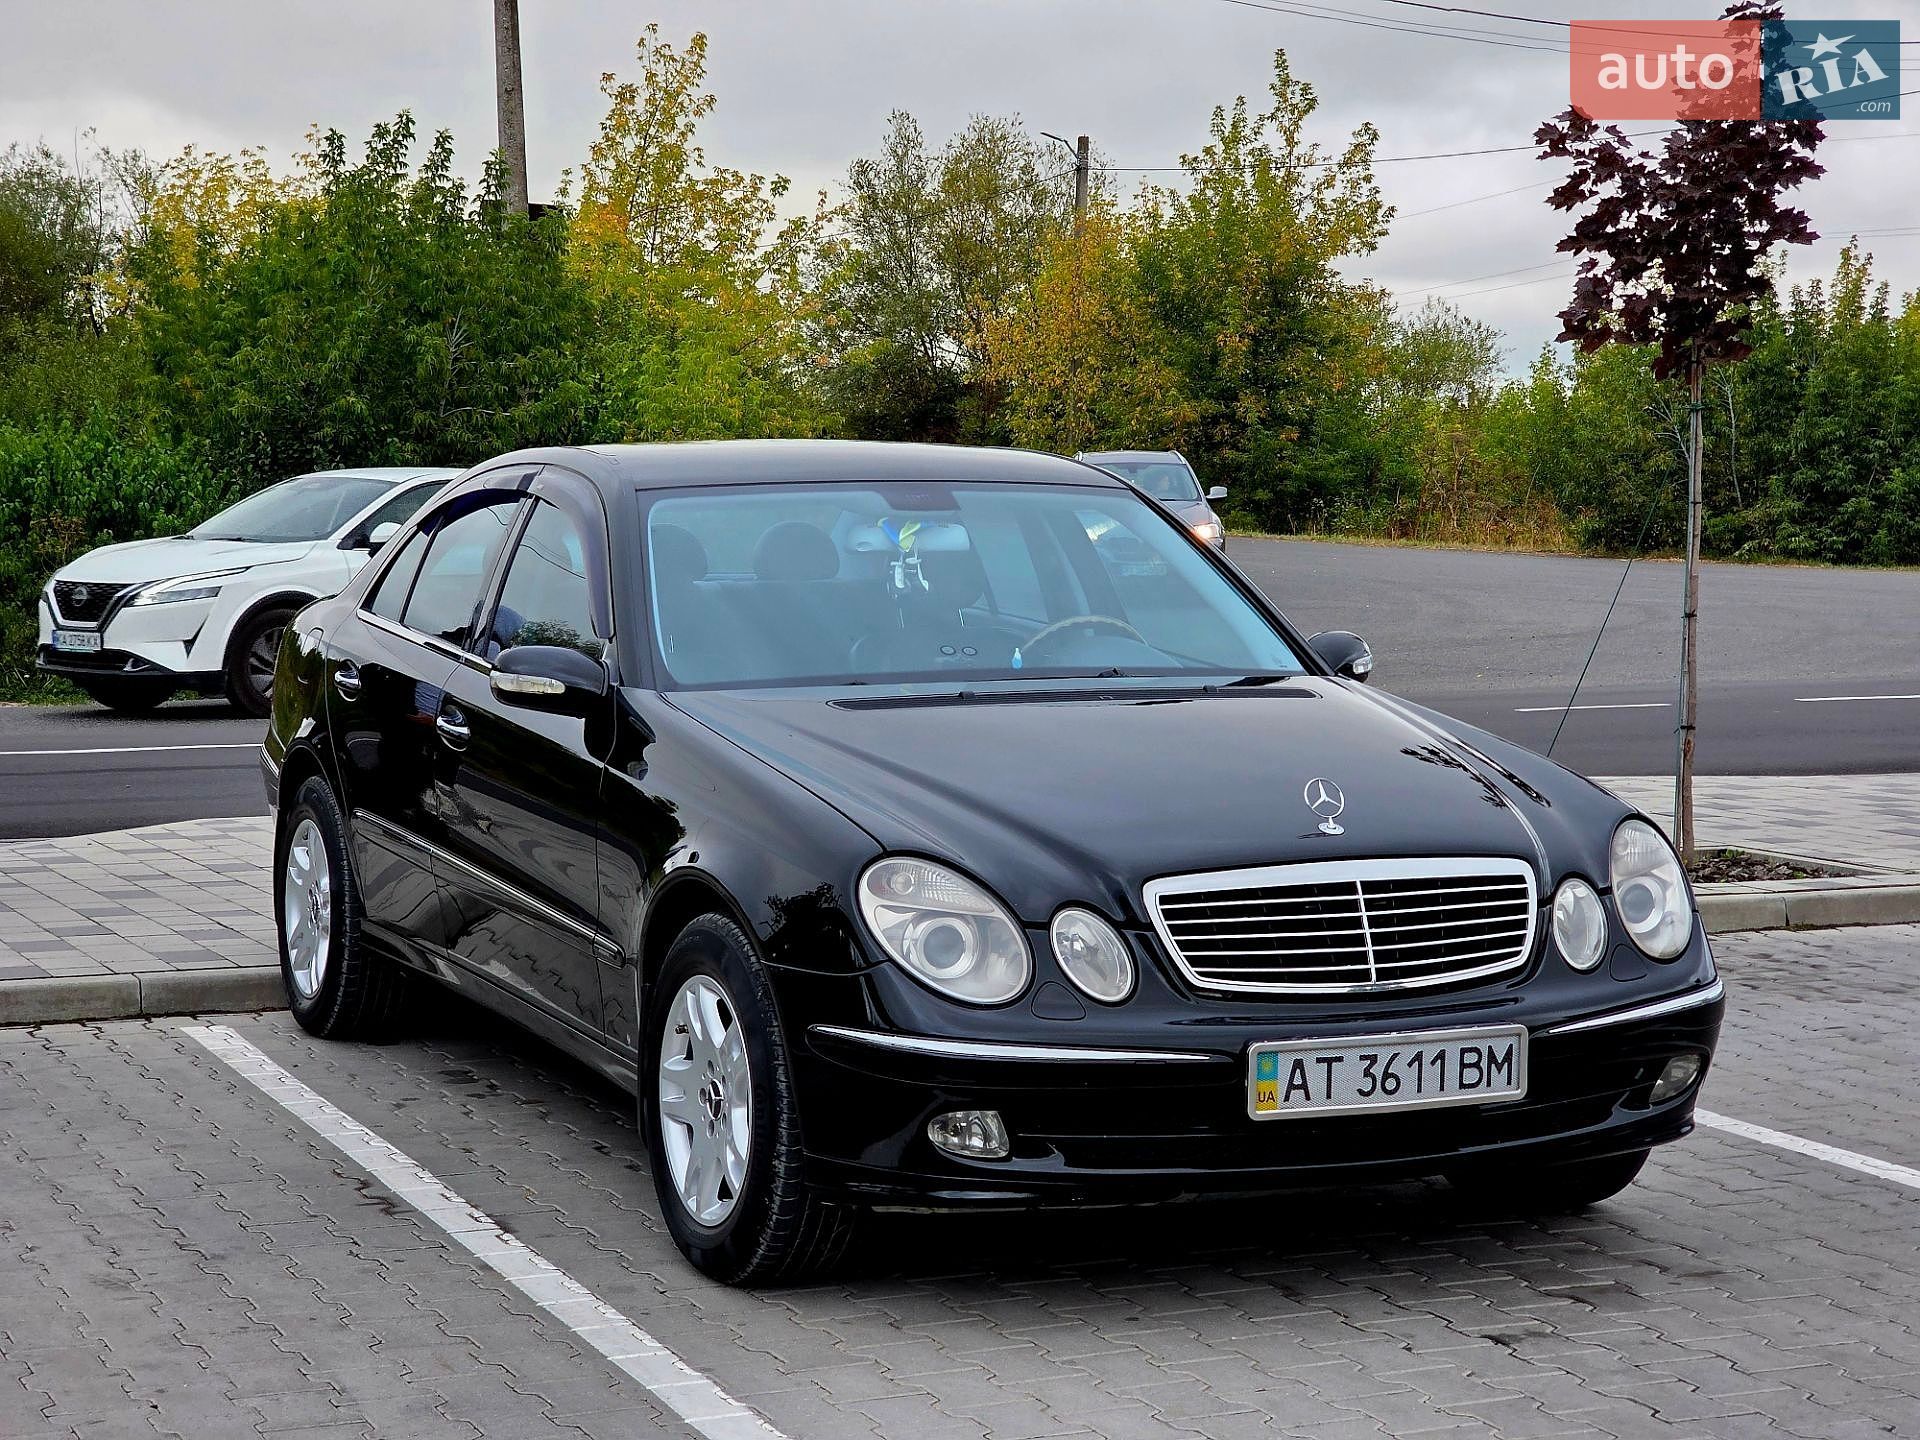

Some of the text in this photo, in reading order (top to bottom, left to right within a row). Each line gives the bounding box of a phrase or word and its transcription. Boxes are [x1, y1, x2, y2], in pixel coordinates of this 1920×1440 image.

[1283, 1043, 1514, 1103] AT 3611 BM
[1257, 1091, 1276, 1104] UA
